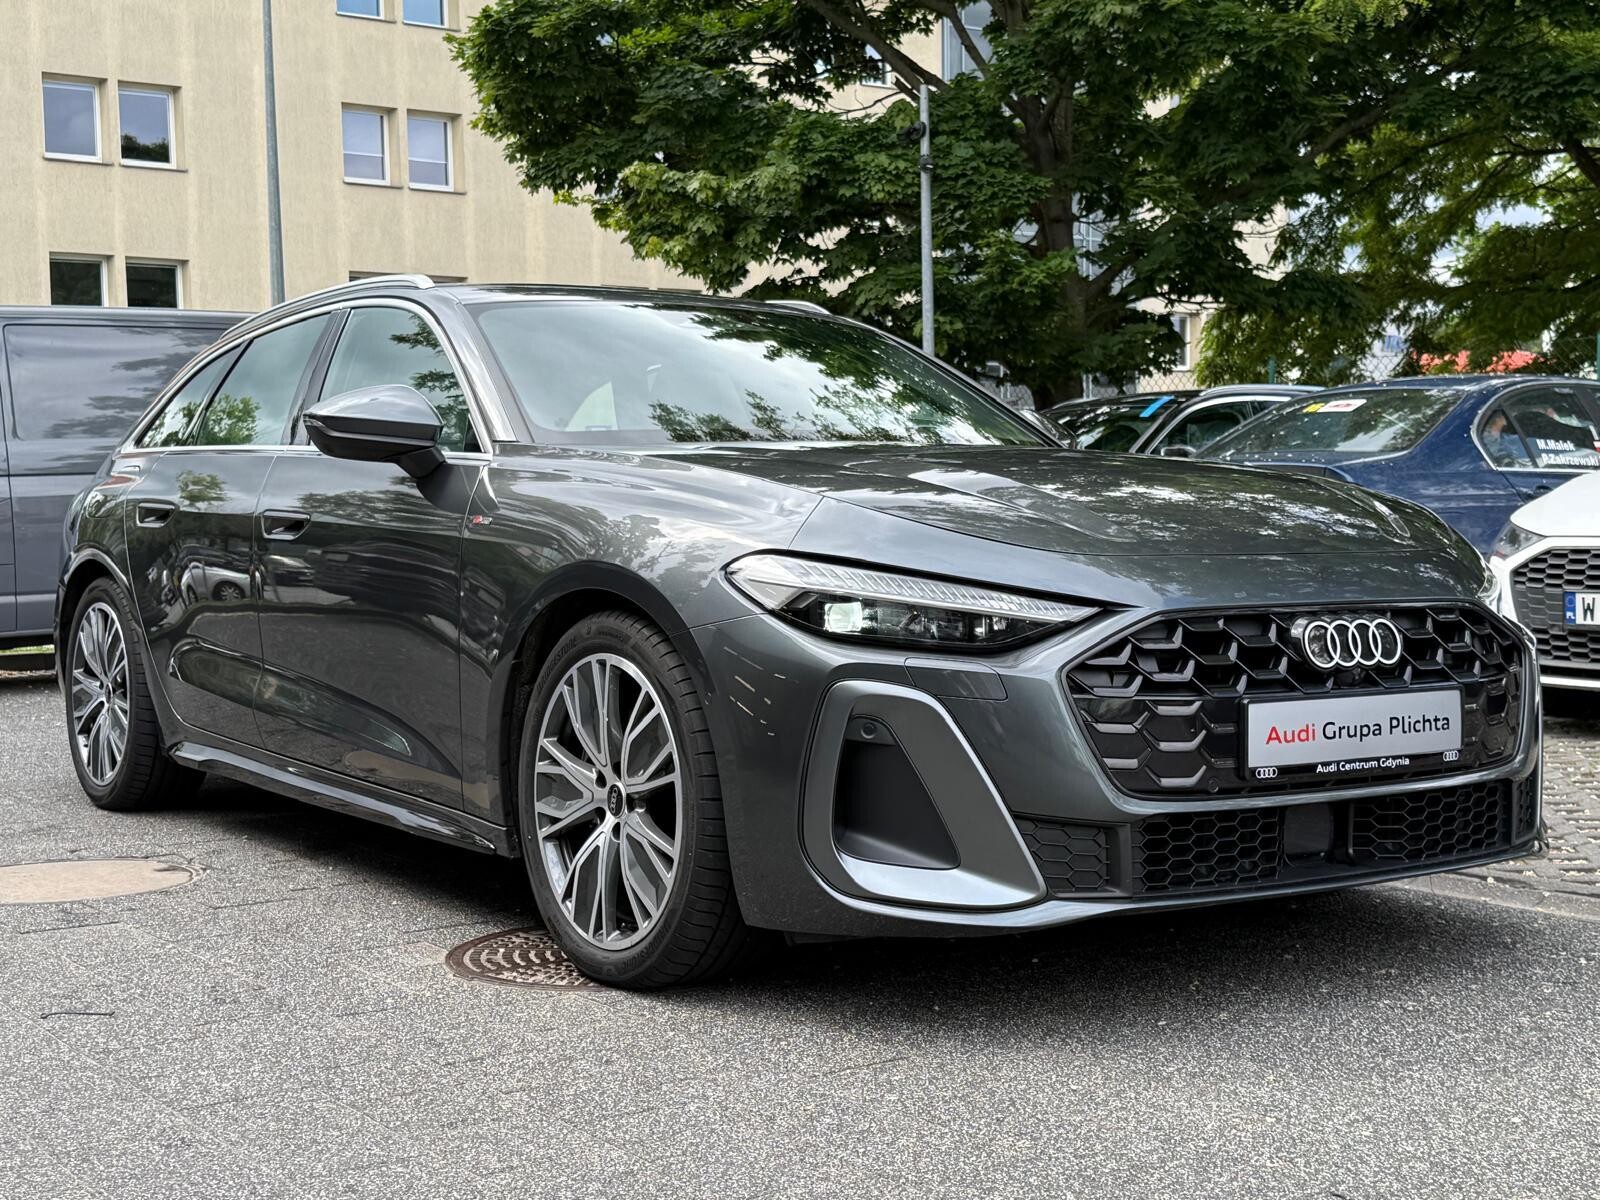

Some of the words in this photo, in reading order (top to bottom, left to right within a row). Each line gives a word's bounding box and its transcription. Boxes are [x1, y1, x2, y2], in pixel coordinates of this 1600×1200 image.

[1536, 439, 1575, 451] M.Malek
[1265, 723, 1316, 745] Audi
[1322, 721, 1382, 742] Grupa
[1389, 714, 1450, 735] Plichta
[1316, 763, 1338, 774] Audi
[1339, 760, 1378, 771] Centrum
[1379, 756, 1410, 769] Gdynia
